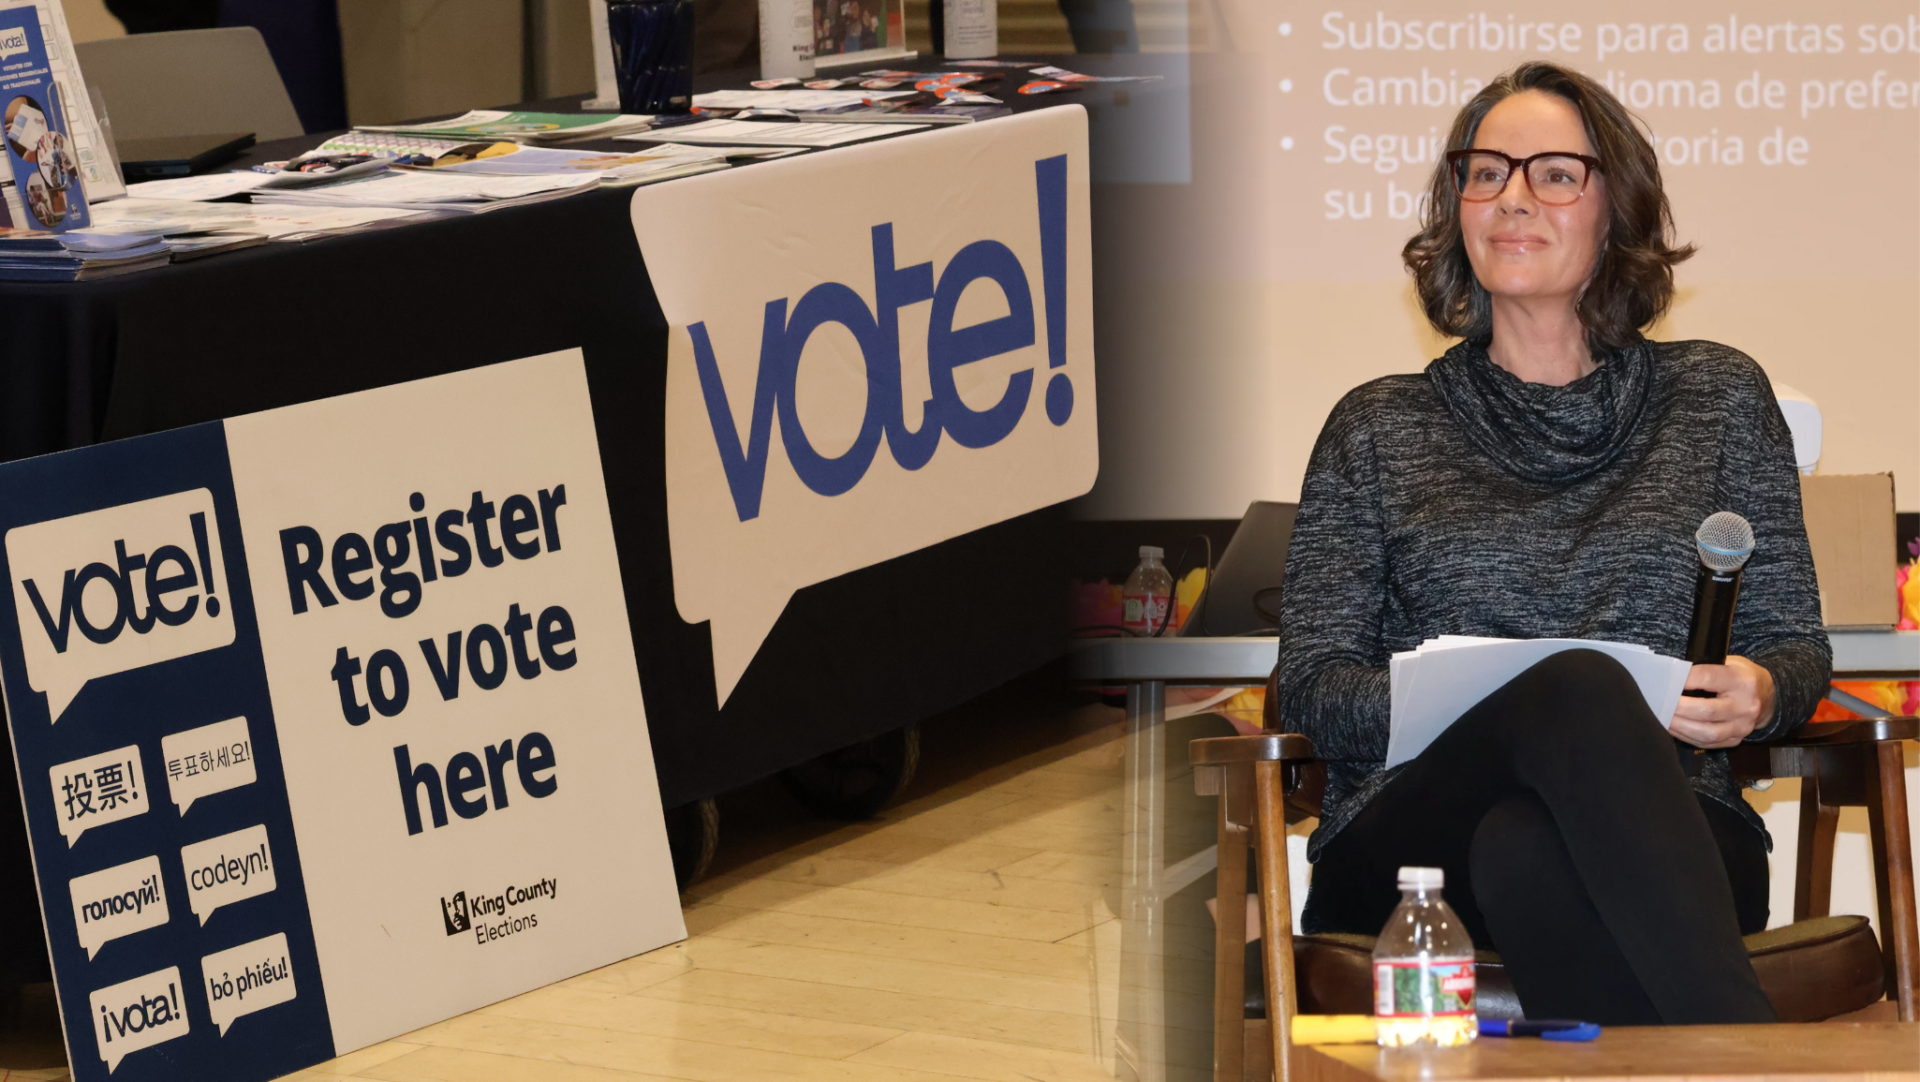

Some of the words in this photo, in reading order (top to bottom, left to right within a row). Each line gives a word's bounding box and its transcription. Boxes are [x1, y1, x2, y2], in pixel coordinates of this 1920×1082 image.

[1321, 10, 1583, 52] Subscribirse
[1596, 22, 1690, 62] para
[1702, 13, 1846, 54] alertas
[1322, 67, 1483, 107] Cambia
[1734, 70, 1787, 109] de
[1323, 125, 1438, 174] Segui
[1757, 126, 1810, 166] de
[1324, 188, 1372, 220] su
[686, 153, 1075, 524] vote!
[278, 483, 568, 619] Register
[21, 511, 221, 655] vote!
[330, 645, 411, 727] to
[417, 602, 578, 702] vote
[167, 740, 251, 782] 투표하세요!
[392, 731, 559, 837] here
[61, 760, 139, 821] 投票!
[190, 843, 270, 892] codeyn!
[81, 874, 161, 924] голосуй!
[470, 894, 506, 918] King
[505, 877, 557, 906] County
[475, 913, 538, 945] Elections
[210, 972, 234, 1002] bỏ
[236, 956, 289, 1001] phiếu!
